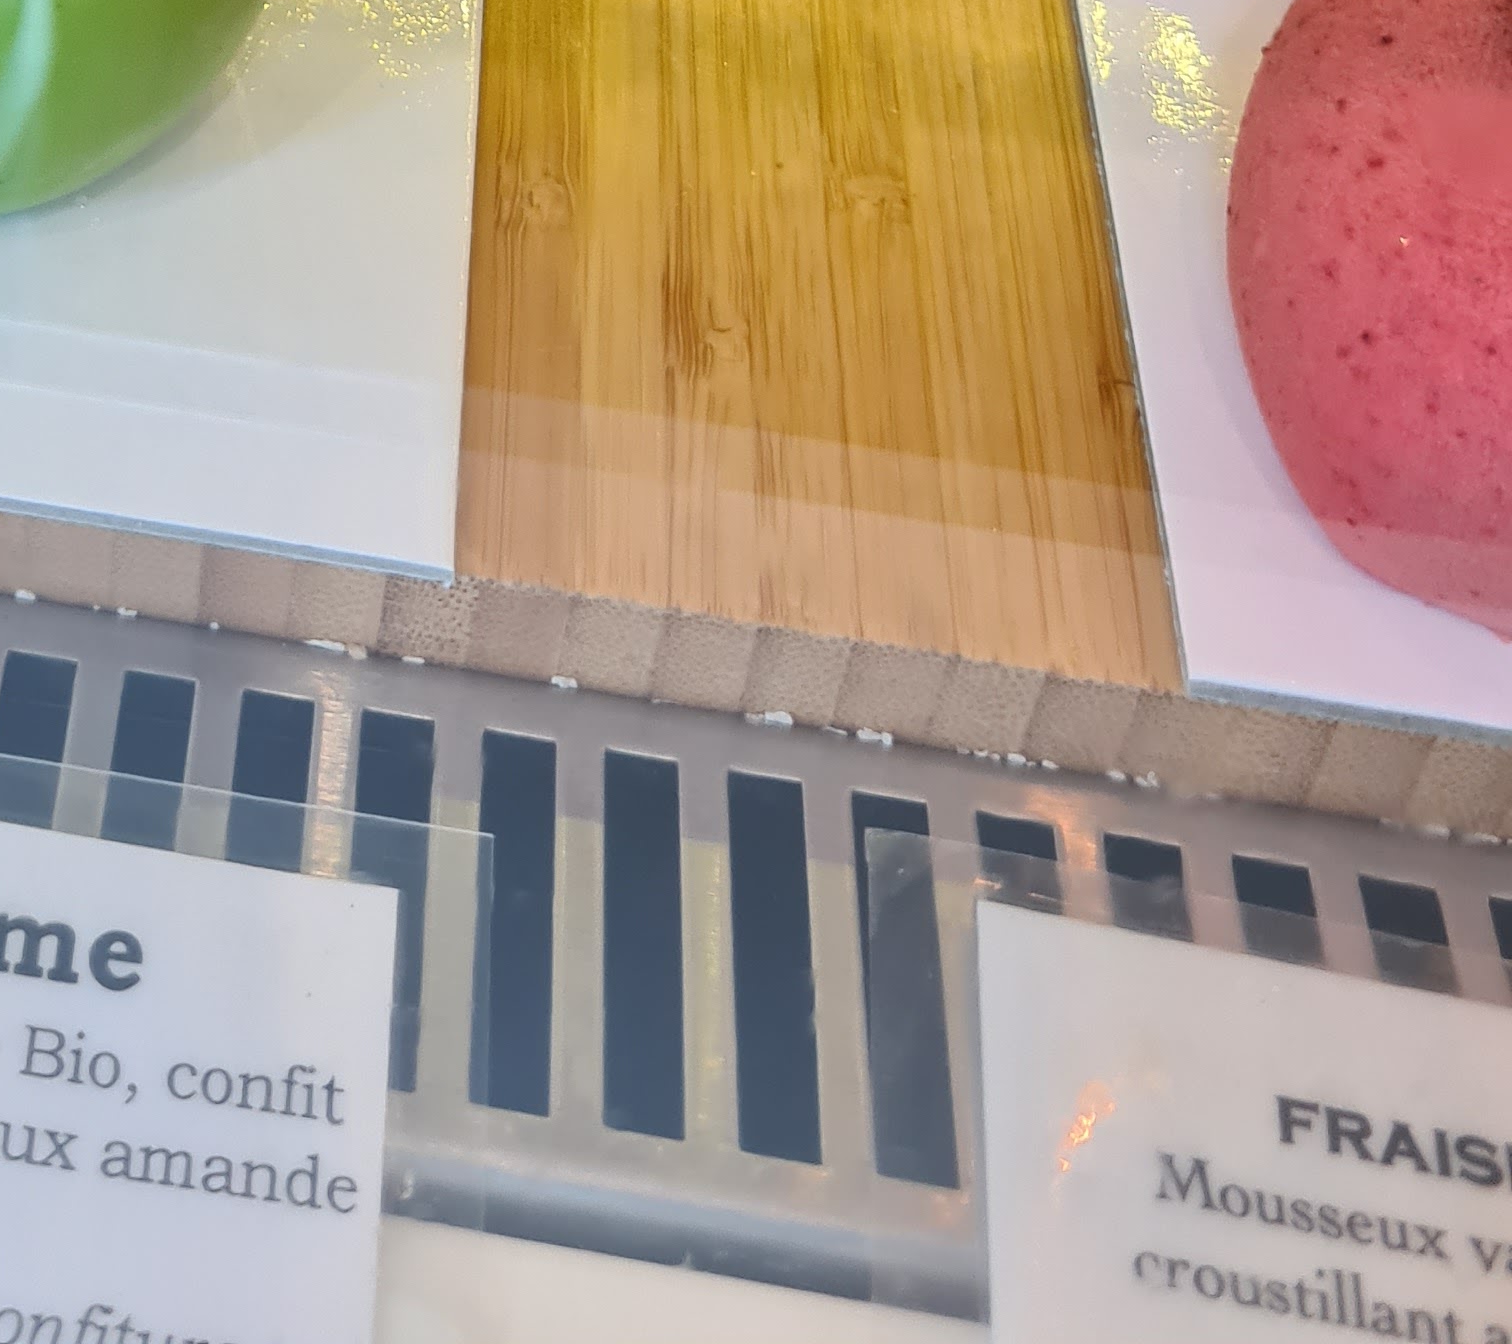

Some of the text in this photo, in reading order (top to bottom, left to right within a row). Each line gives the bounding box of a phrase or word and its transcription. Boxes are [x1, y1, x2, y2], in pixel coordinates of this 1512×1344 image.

[19, 1025, 137, 1104] Bio,
[167, 1063, 344, 1125] confit
[100, 1141, 357, 1214] amande
[1276, 1095, 1512, 1191] FRAIS
[1156, 1152, 1448, 1261] Mousseux
[1132, 1251, 1461, 1344] croustillant
